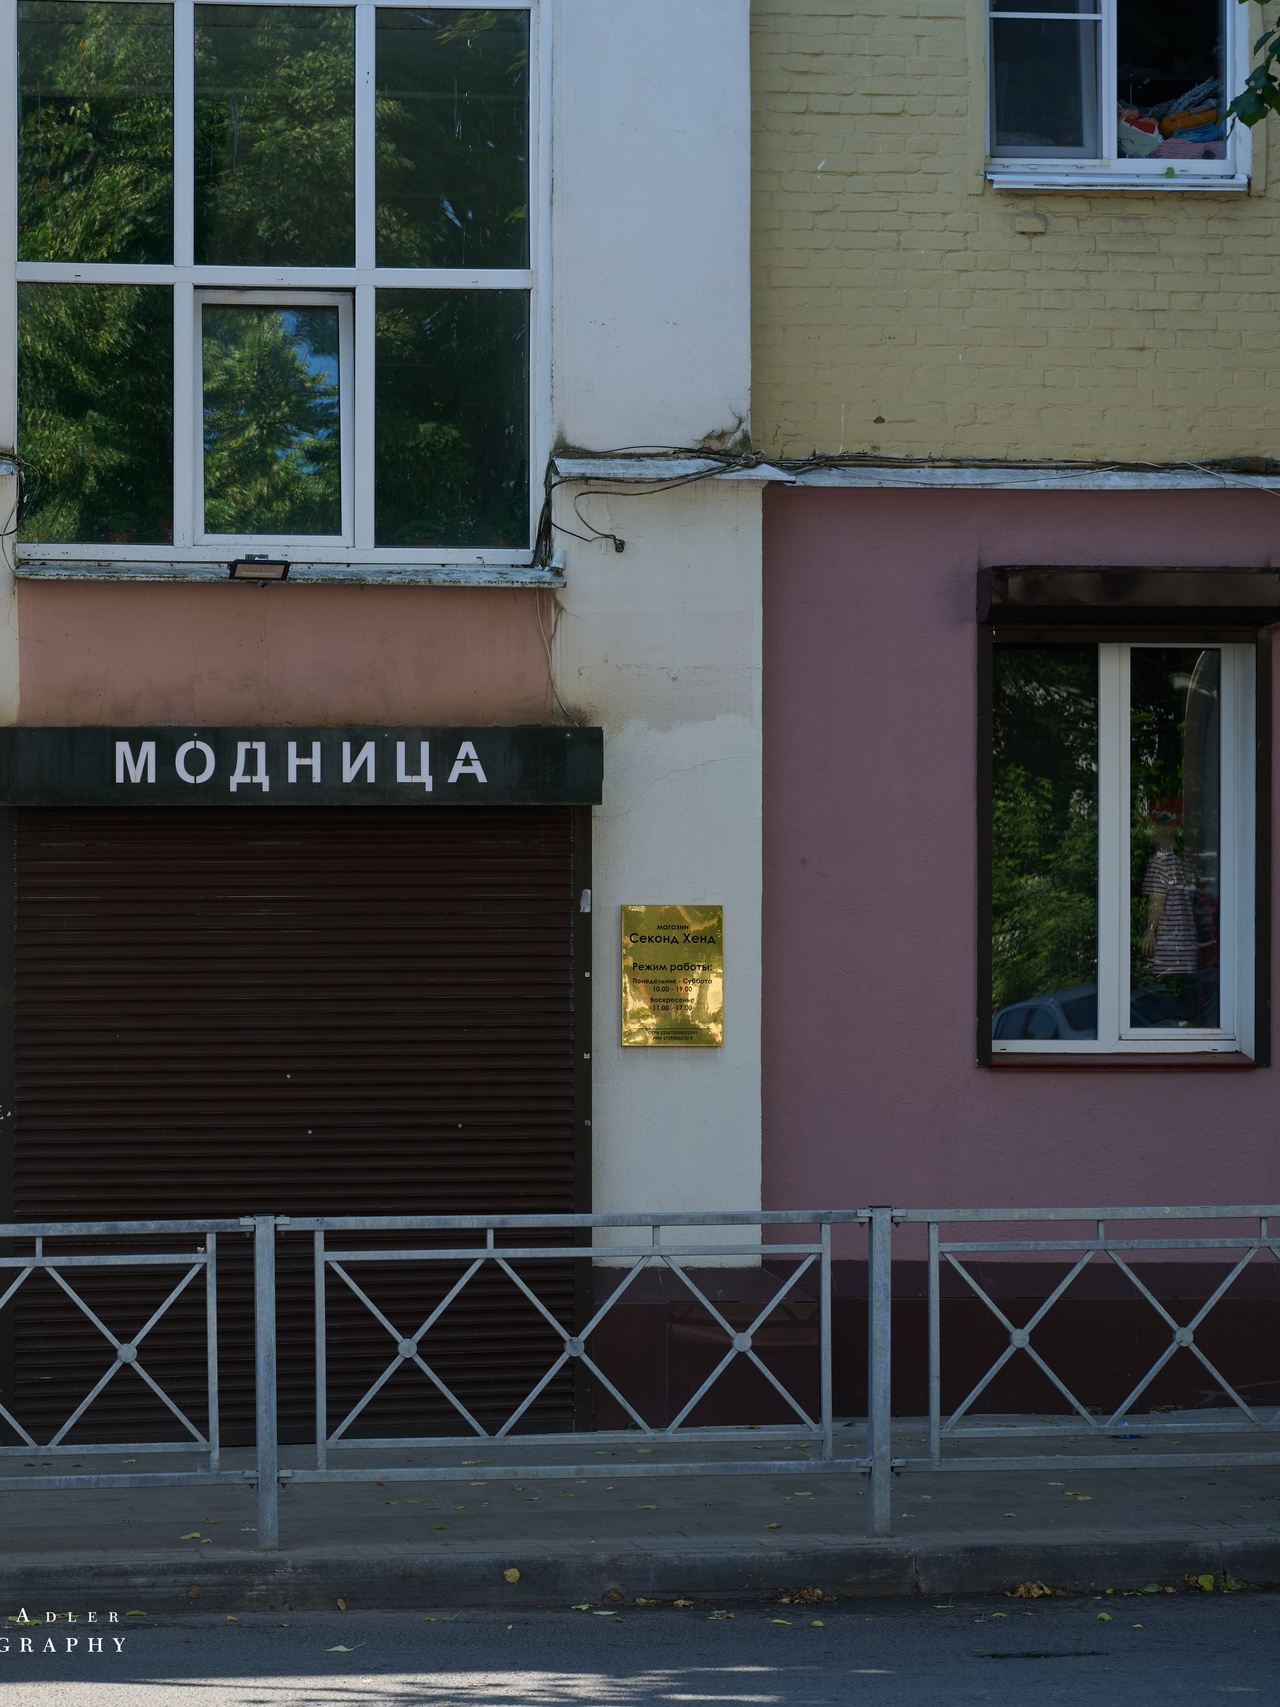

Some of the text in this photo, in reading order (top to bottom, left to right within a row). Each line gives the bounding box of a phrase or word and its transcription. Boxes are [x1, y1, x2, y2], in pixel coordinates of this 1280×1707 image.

[115, 741, 488, 792] МОДНИЦА
[629, 932, 716, 944] Секонд Хенд
[632, 962, 712, 972] Режим работы:
